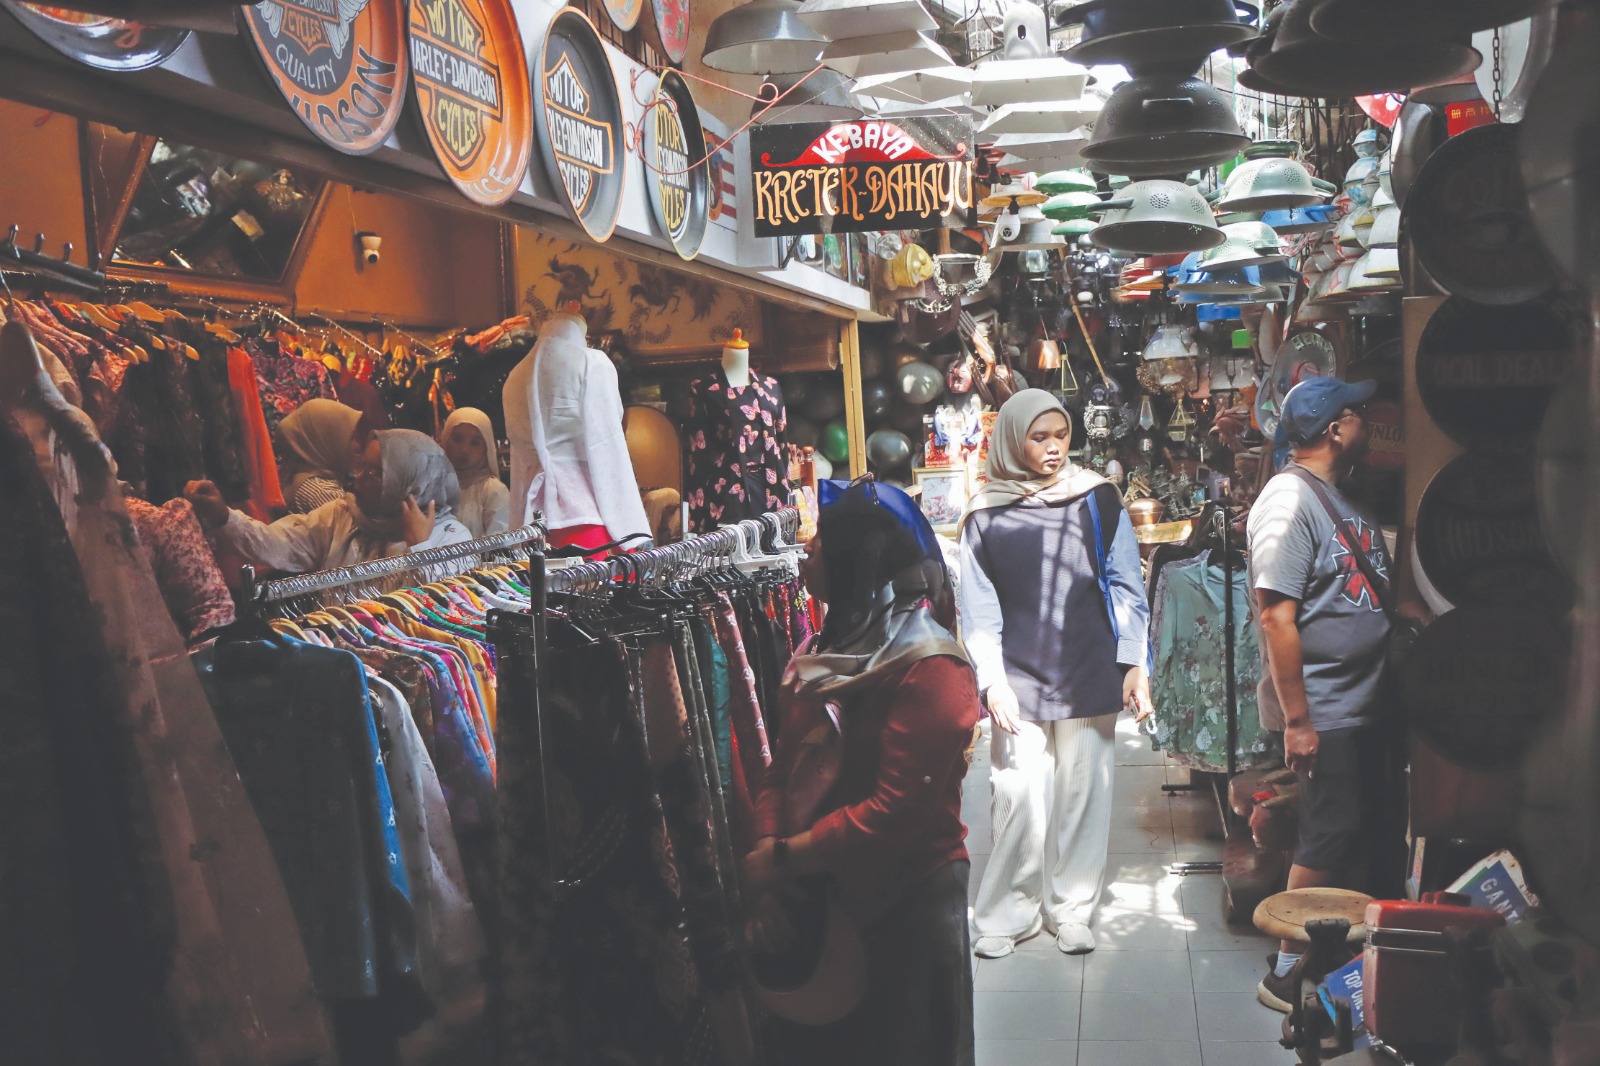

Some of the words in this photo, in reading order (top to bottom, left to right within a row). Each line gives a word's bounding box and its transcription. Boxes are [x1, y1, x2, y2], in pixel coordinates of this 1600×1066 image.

[287, 10, 322, 47] CYCLES
[427, 0, 475, 52] MOTOR
[276, 43, 337, 89] QUALITY
[550, 61, 584, 113] MOTOR
[438, 98, 477, 157] CYCLES
[811, 123, 915, 164] KEBAYA
